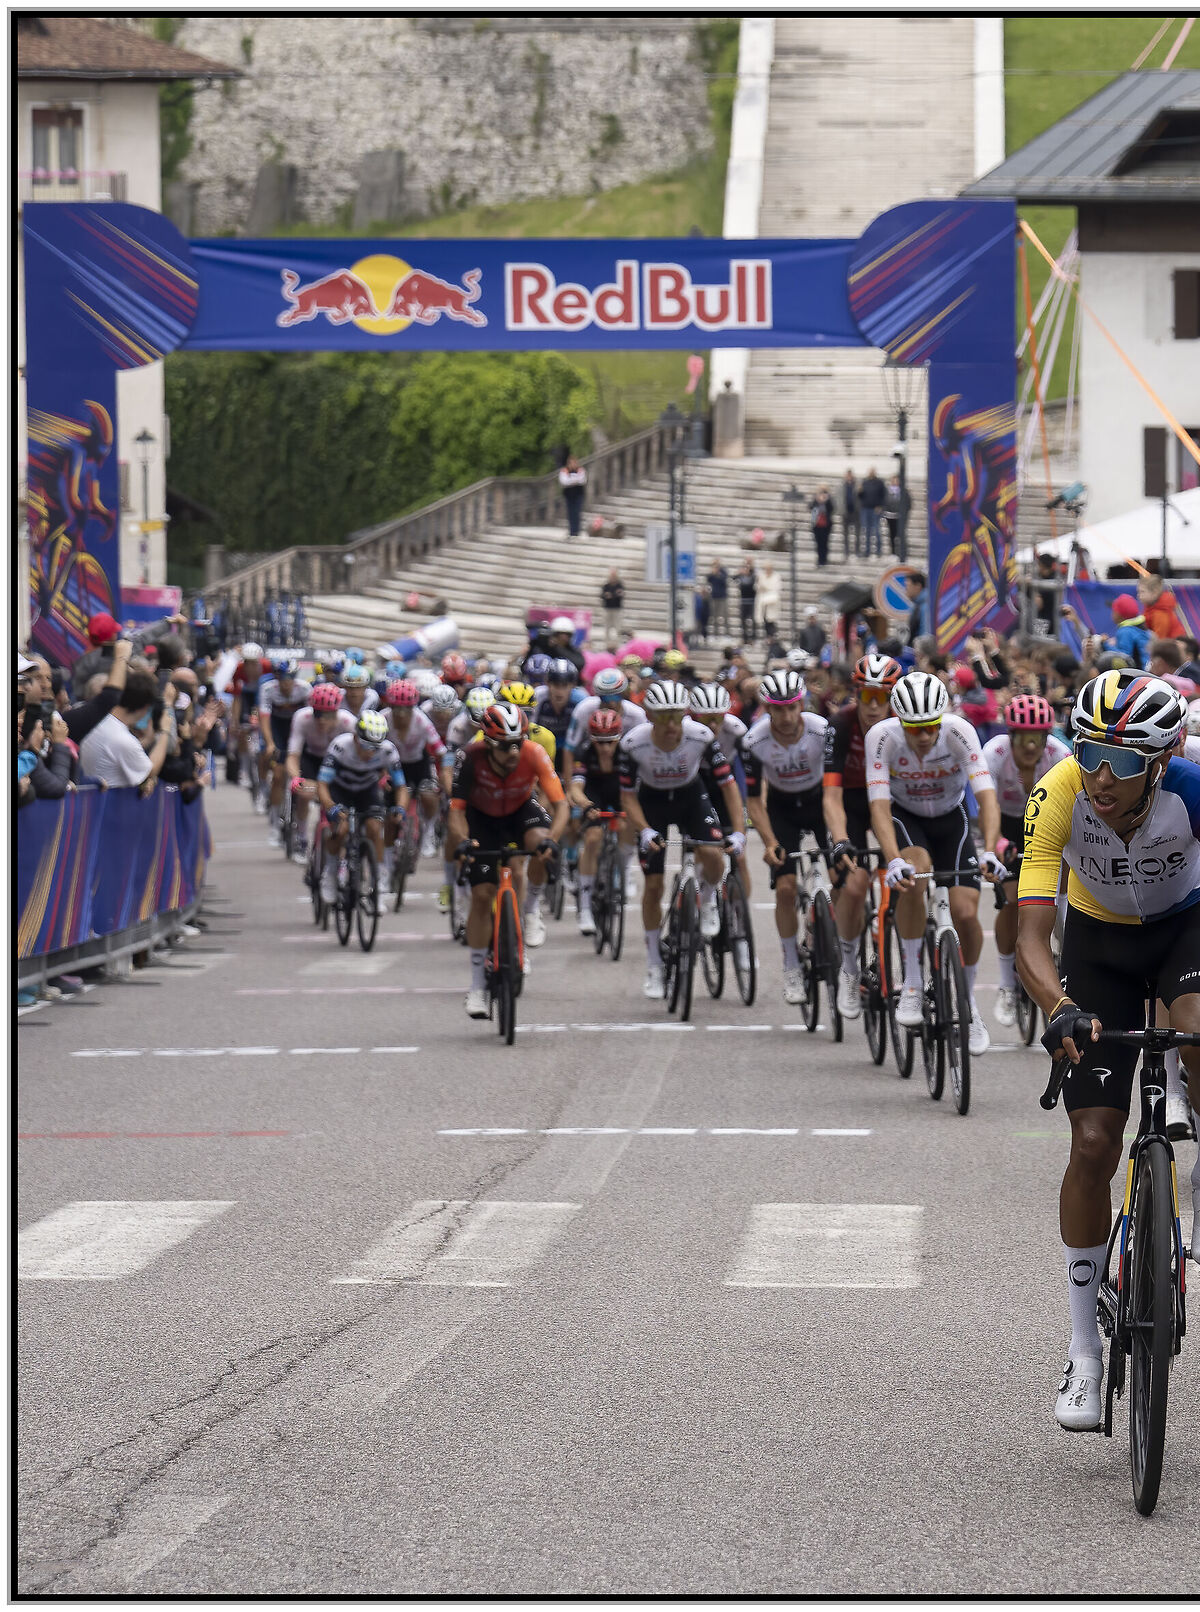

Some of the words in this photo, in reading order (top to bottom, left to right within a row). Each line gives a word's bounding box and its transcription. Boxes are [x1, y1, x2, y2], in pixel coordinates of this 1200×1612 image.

[507, 262, 637, 328] Red
[645, 262, 770, 328] Bull
[1083, 831, 1110, 846] GOBIK
[1079, 851, 1185, 878] INEOS
